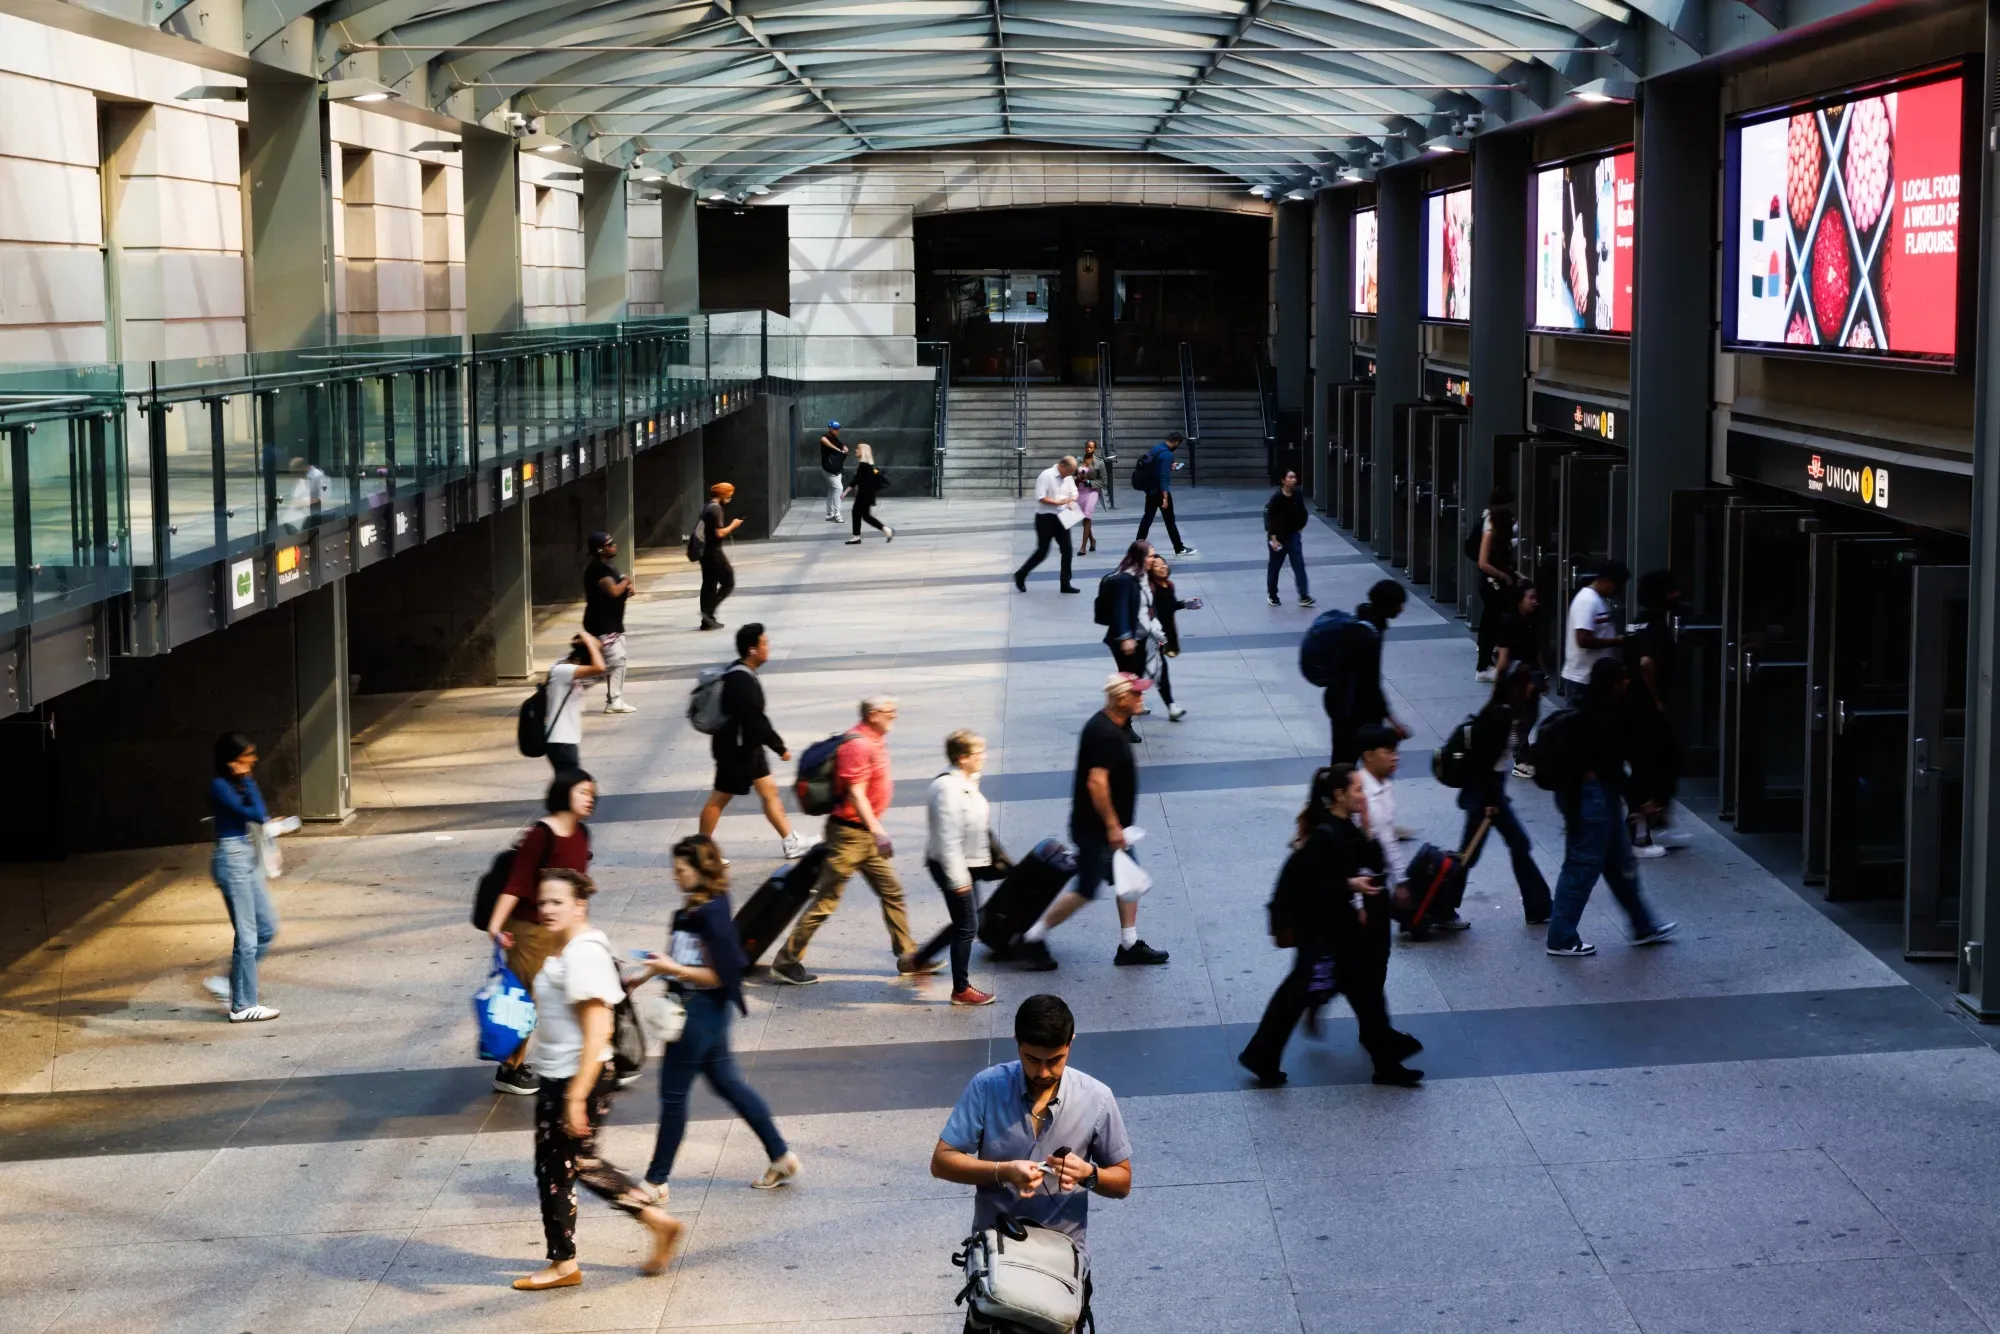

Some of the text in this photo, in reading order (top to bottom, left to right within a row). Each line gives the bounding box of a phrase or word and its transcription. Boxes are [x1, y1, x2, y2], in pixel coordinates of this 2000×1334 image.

[1902, 174, 1960, 202] LOCAL FOOD
[1903, 202, 1960, 228] A WORLD OF
[1905, 230, 1957, 255] FLAVOURS.
[1583, 412, 1600, 431] UNION
[1808, 479, 1823, 492] SUBWAY
[1826, 464, 1860, 493] UNION
